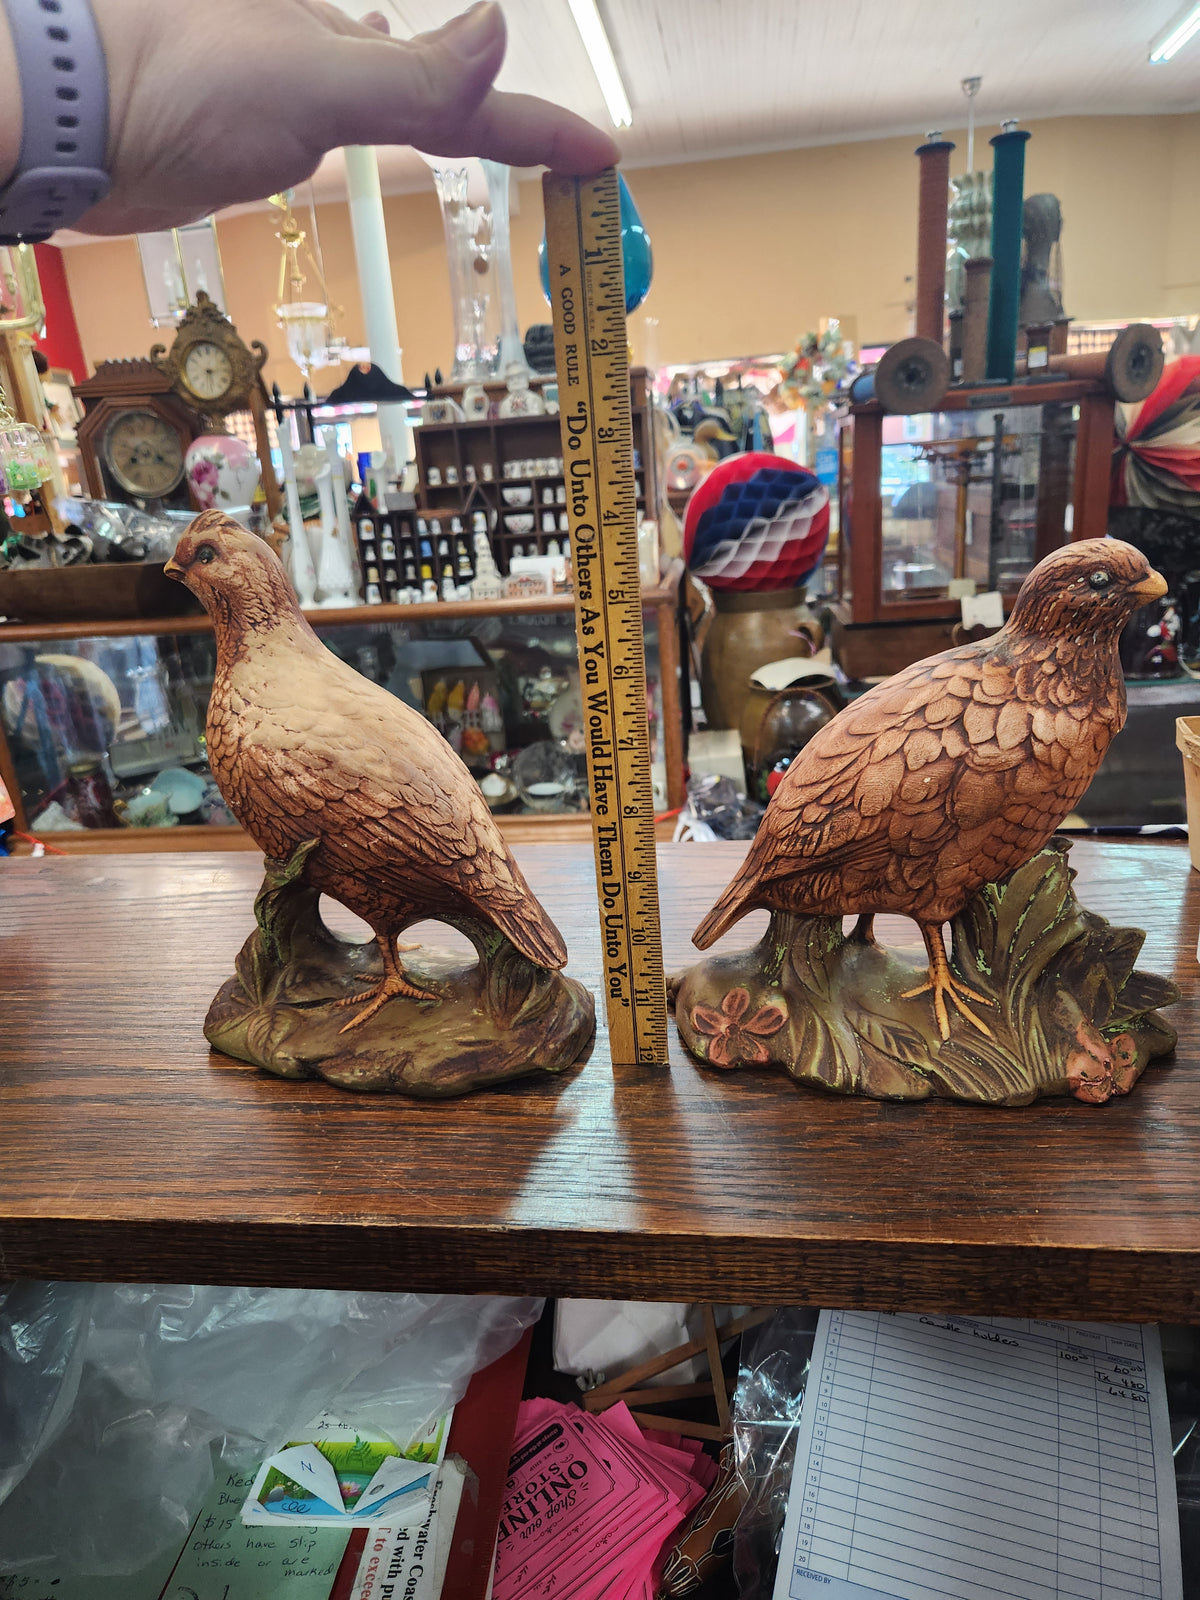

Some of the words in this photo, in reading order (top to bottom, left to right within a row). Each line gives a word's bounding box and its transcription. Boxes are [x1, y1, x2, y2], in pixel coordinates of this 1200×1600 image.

[584, 248, 603, 259] 1
[559, 264, 572, 277] A
[561, 287, 576, 335] GOOD
[591, 338, 609, 351] 2
[565, 344, 580, 386] RULE
[598, 427, 615, 439] 3
[570, 459, 592, 517] Unto
[603, 510, 620, 521] 4
[575, 524, 597, 600] Others
[608, 589, 625, 600] 5
[581, 607, 600, 635] As
[584, 641, 604, 685] You
[613, 665, 630, 675] 6
[587, 690, 612, 759] Would
[618, 737, 634, 746] 7
[593, 764, 613, 815] Have
[623, 805, 639, 815] 8
[598, 822, 618, 877] Them
[627, 871, 643, 880] 9
[602, 882, 621, 909] Do
[605, 914, 623, 958] Unto
[631, 927, 646, 942] 10
[634, 988, 650, 1003] 11
[639, 1046, 654, 1061] 12
[973, 1329, 1020, 1348] holders
[503, 1463, 560, 1514] STORE
[218, 1491, 241, 1506] Blue
[545, 1489, 577, 1519] Shop
[520, 1518, 542, 1539] our
[803, 1522, 811, 1530] 18
[193, 1537, 232, 1551] others
[246, 1538, 276, 1549] have
[373, 1538, 387, 1552] to
[197, 1558, 241, 1568] inside
[257, 1559, 271, 1567] or
[282, 1556, 310, 1566] are
[387, 1546, 405, 1579] with
[798, 1555, 806, 1563] 20
[284, 1564, 335, 1577] marked
[796, 1568, 823, 1582] RECEIVED
[823, 1576, 832, 1585] BY
